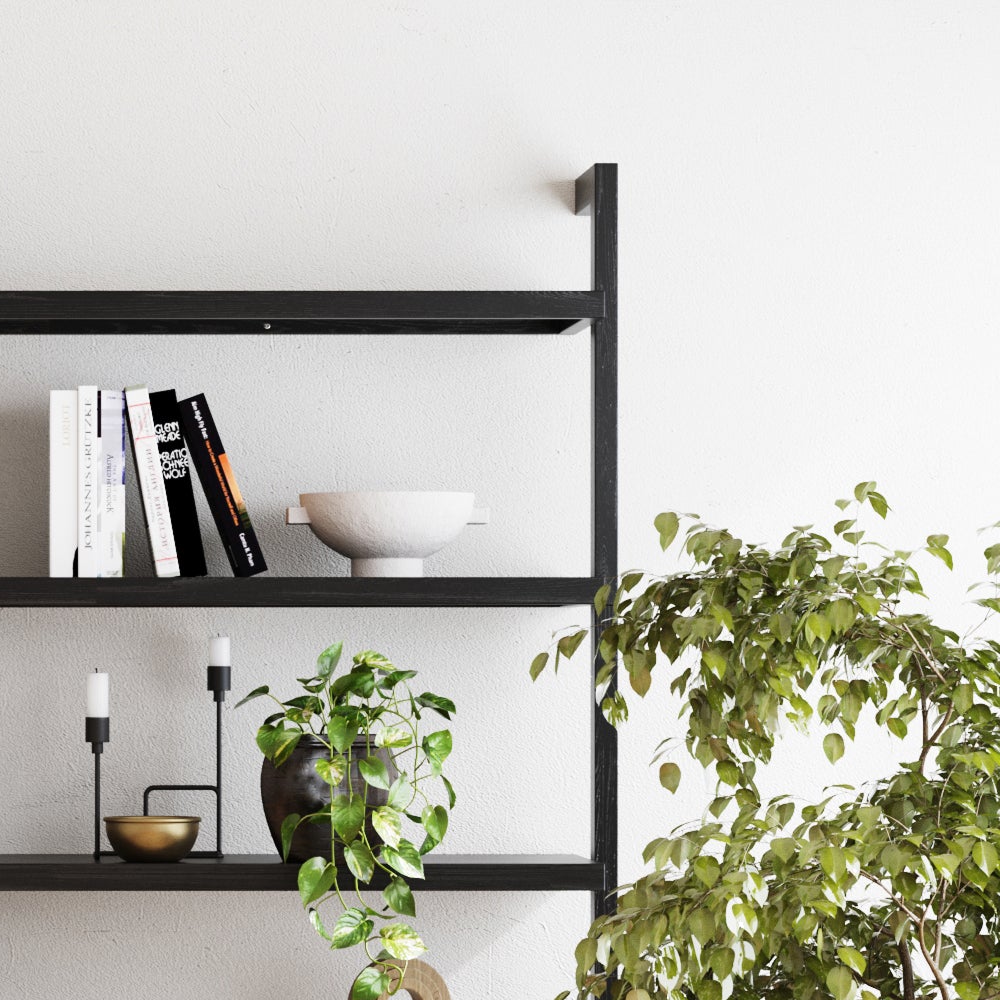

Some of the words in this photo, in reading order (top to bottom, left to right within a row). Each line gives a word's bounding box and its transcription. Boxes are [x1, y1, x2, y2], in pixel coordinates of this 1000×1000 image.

[154, 421, 179, 434] GLENN
[157, 430, 181, 443] MEADE
[163, 468, 187, 479] WOLF
[84, 471, 93, 549] JOHANNES
